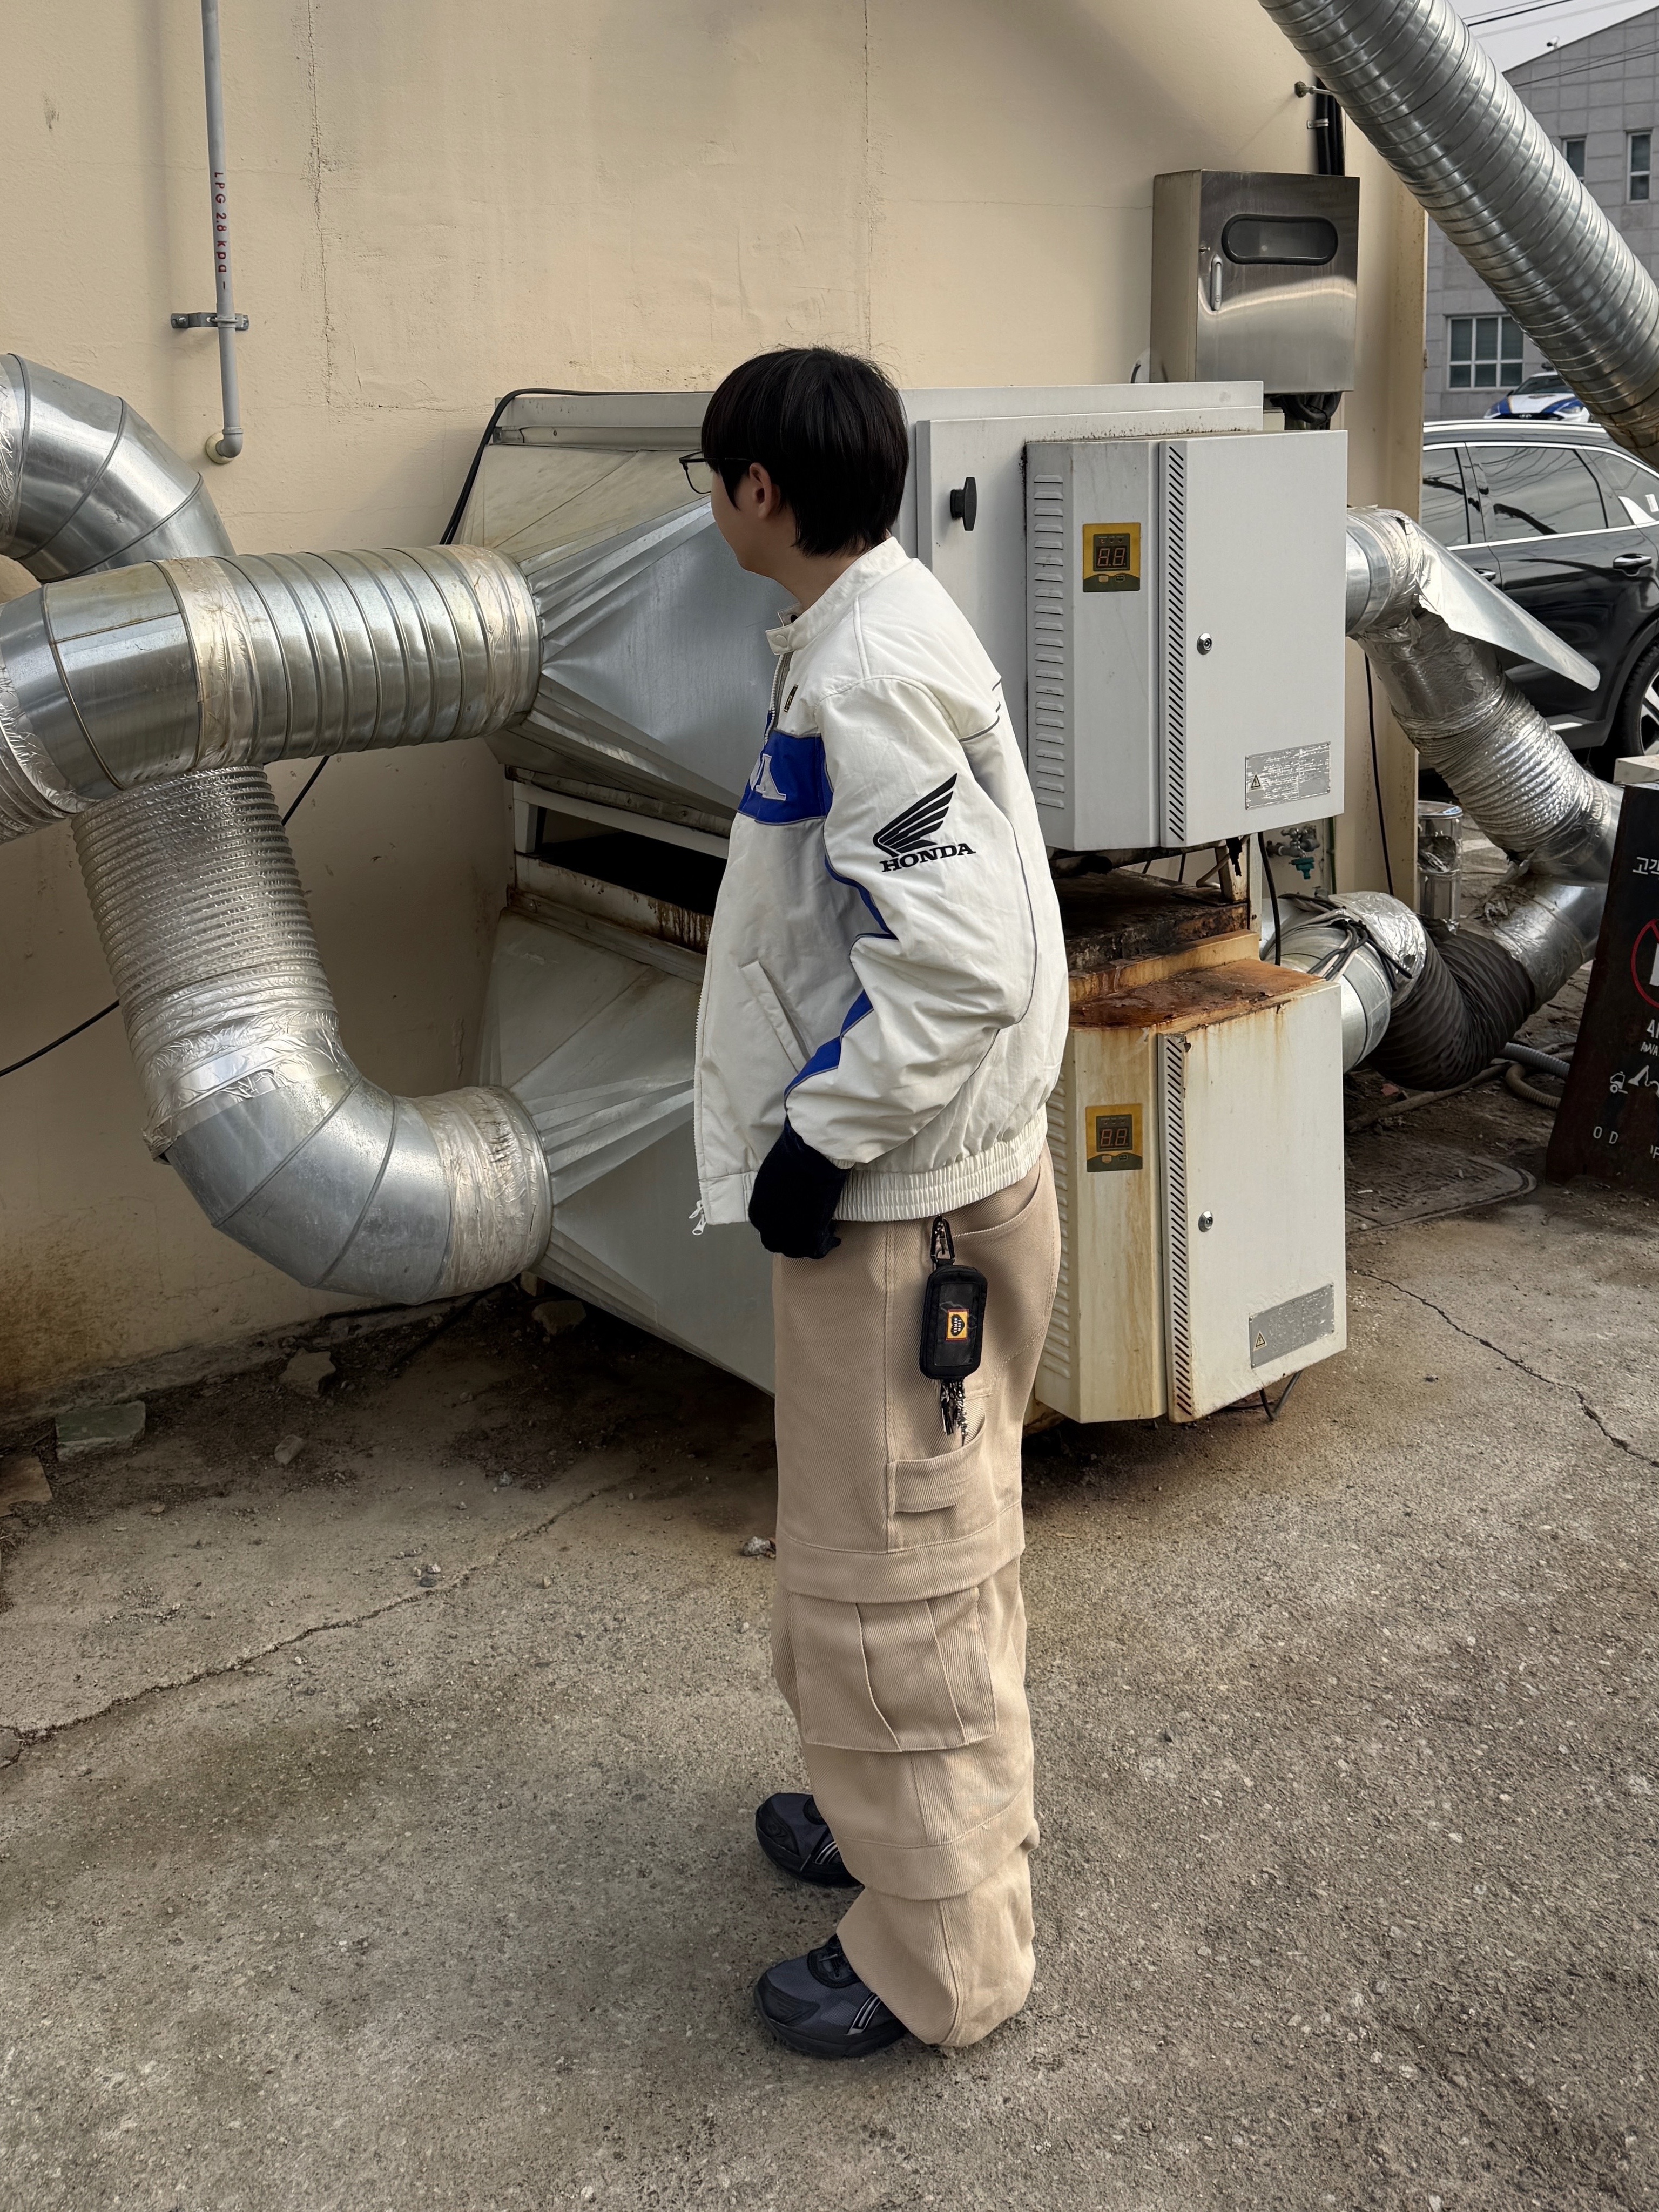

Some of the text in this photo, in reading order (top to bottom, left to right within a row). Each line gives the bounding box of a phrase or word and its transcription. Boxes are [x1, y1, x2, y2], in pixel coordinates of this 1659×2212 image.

[214, 172, 226, 204] LPG
[216, 213, 227, 232] 2.8
[879, 843, 976, 872] HONDA
